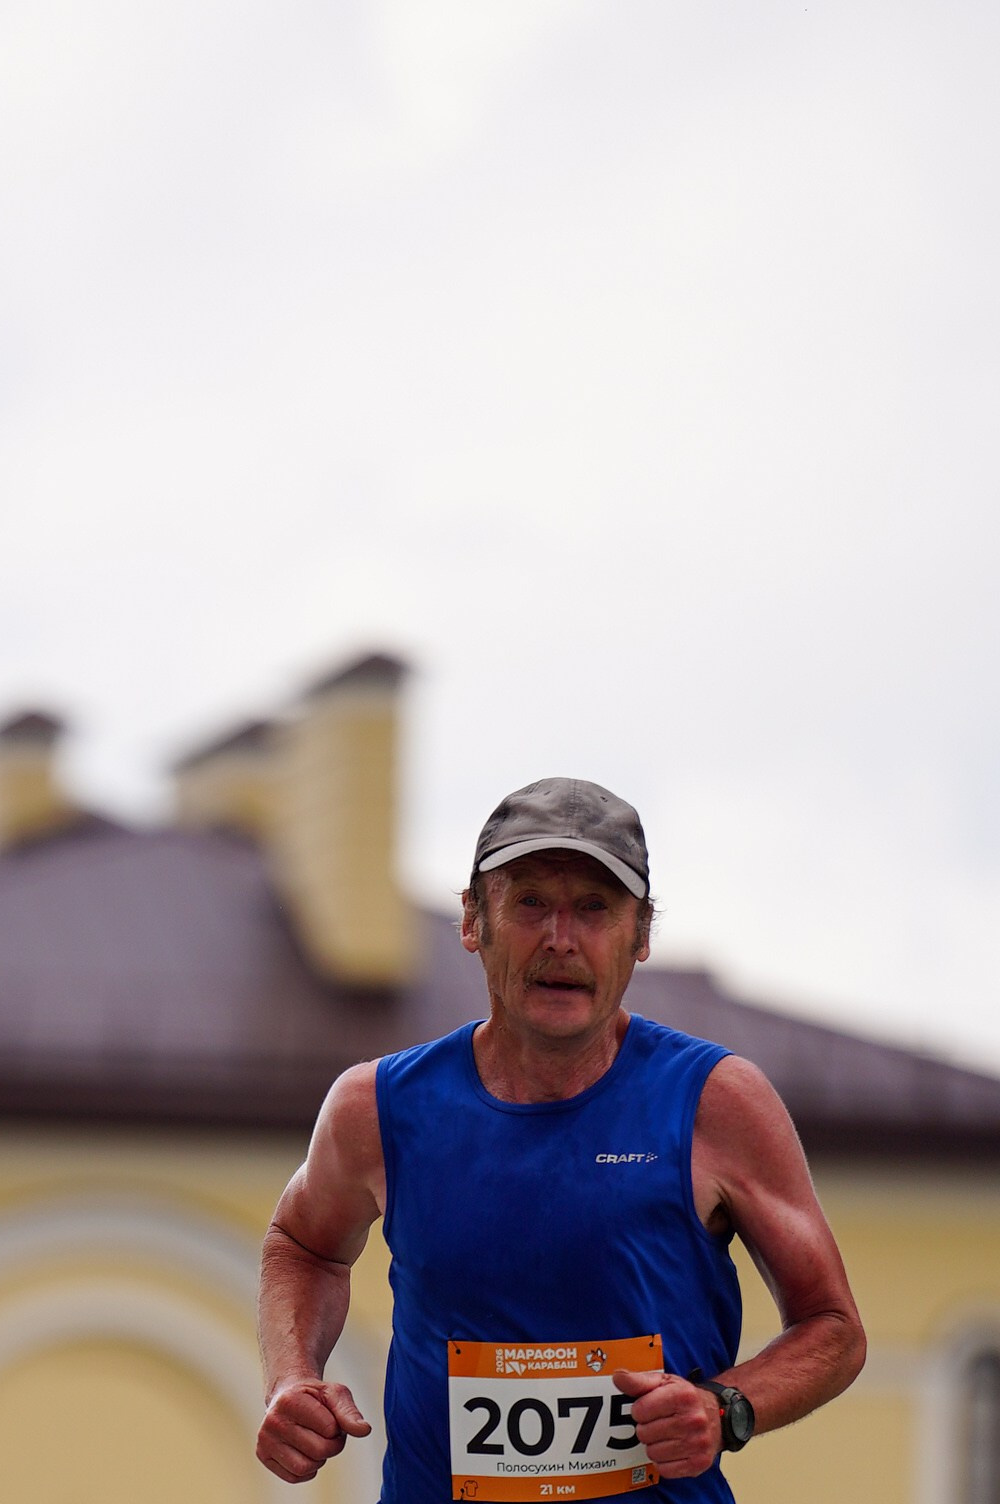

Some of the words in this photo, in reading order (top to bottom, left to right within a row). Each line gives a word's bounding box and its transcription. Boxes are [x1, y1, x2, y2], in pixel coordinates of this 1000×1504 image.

[595, 1153, 646, 1164] CRAFT
[504, 1348, 577, 1360] МАРАФОН
[495, 1348, 503, 1373] 2026
[527, 1360, 577, 1370] КАРАБАШ
[463, 1395, 641, 1456] 2075
[496, 1461, 565, 1475] Полосухин
[569, 1458, 616, 1472] Михаил
[539, 1484, 553, 1495] 21
[556, 1484, 576, 1495] км
